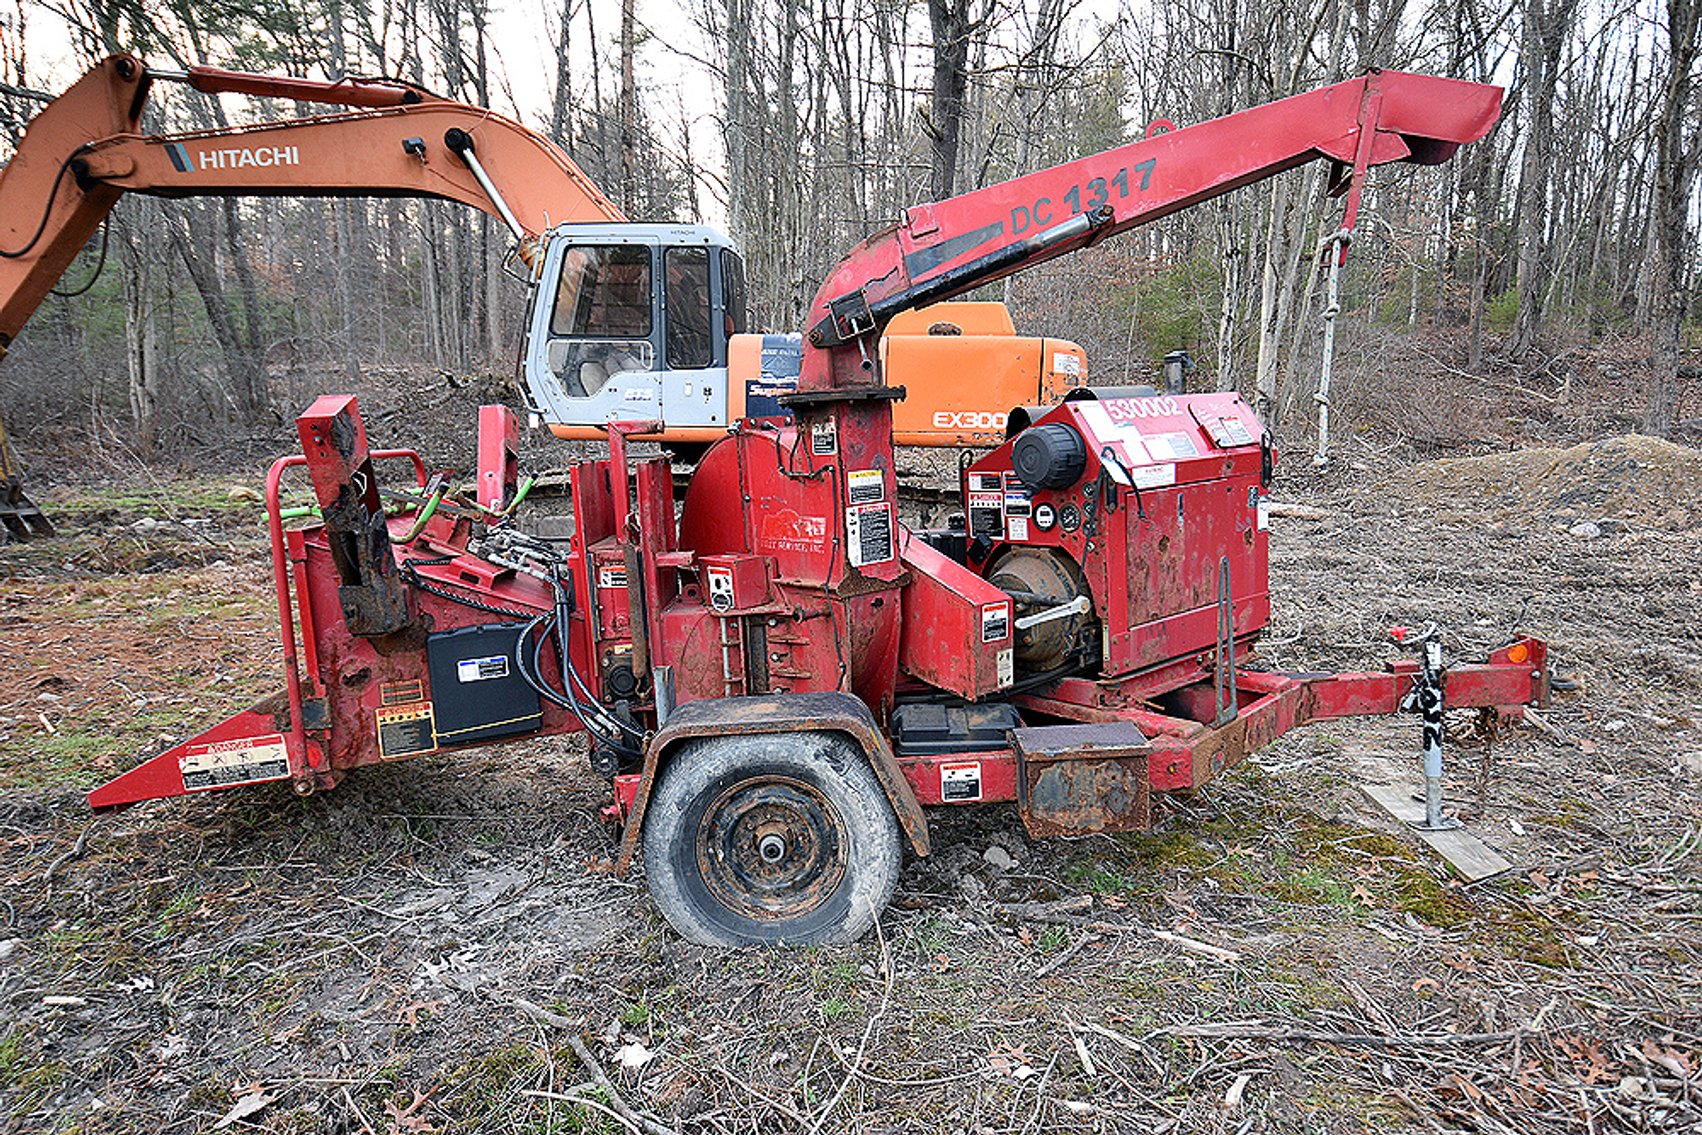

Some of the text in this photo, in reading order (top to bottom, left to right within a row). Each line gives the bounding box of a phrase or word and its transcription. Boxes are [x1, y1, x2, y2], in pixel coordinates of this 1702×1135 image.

[199, 146, 300, 170] HITACHI
[1010, 157, 1157, 235] DC 1317
[933, 411, 1008, 428] EX300
[1104, 398, 1184, 420] 530002
